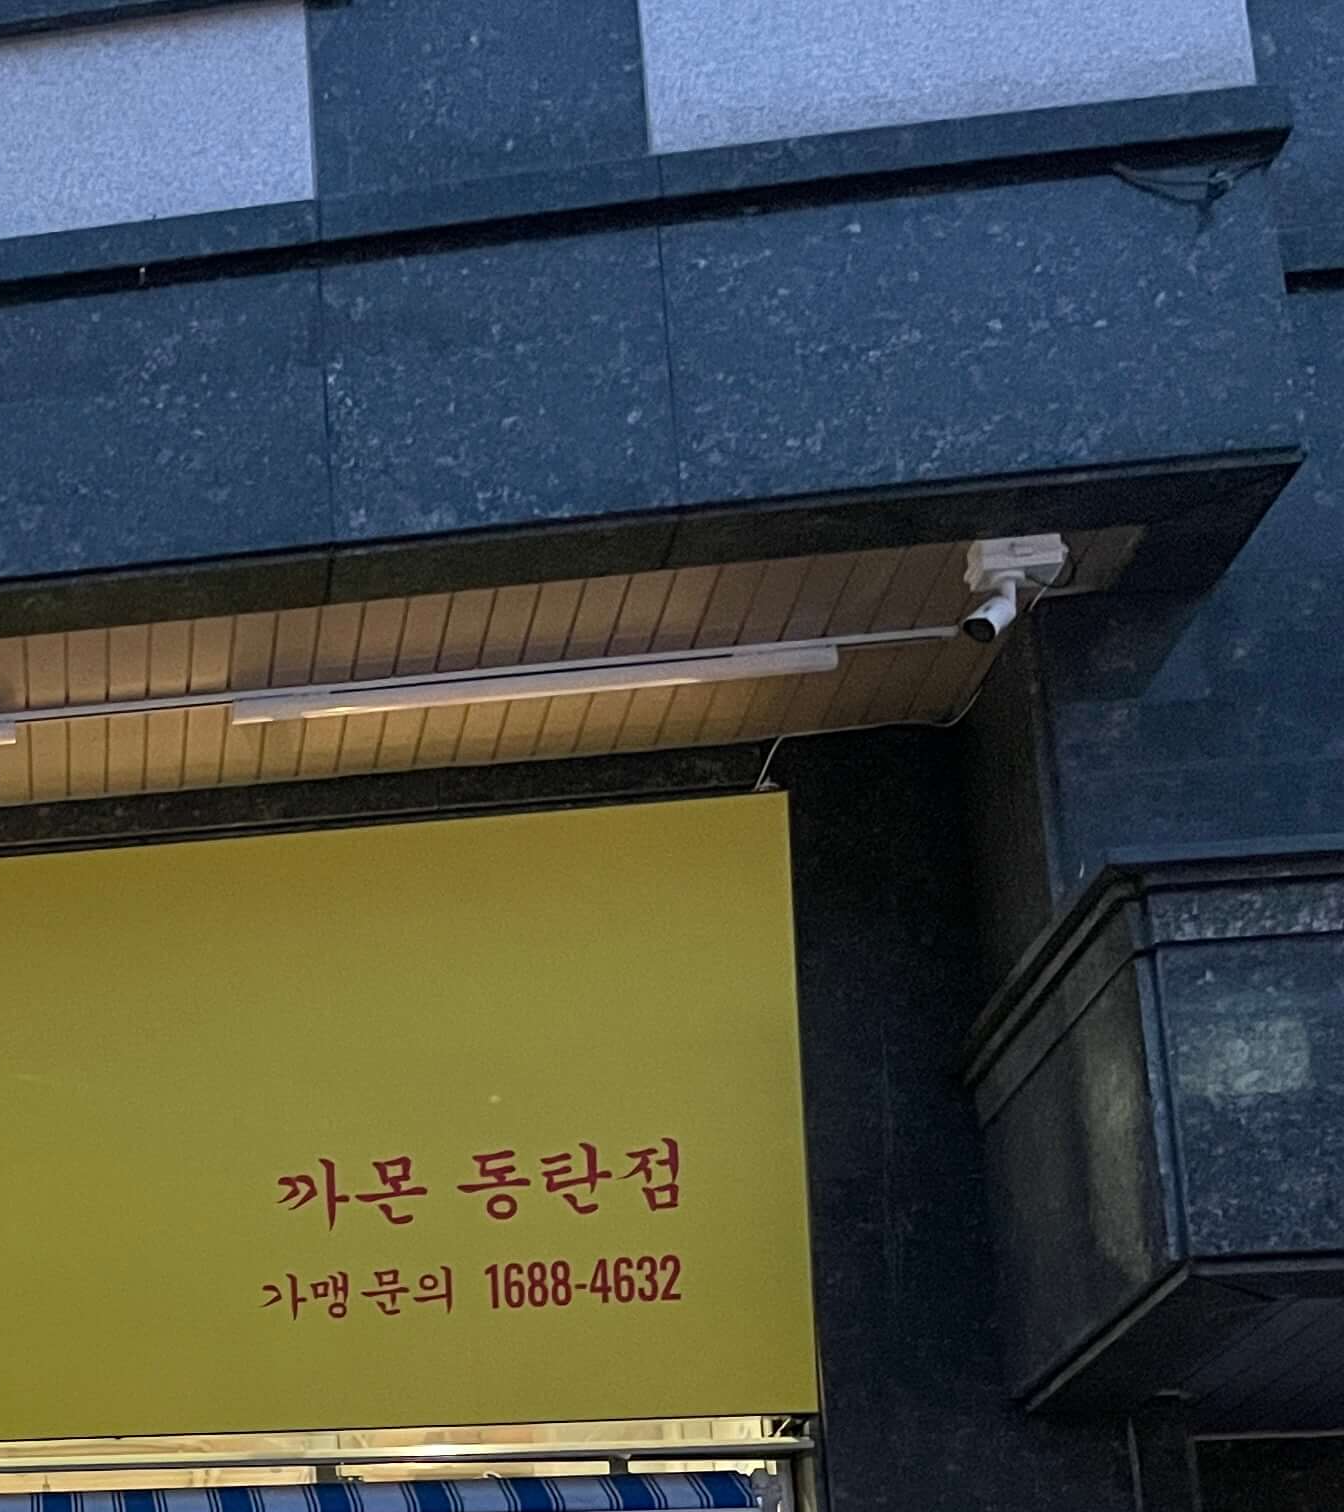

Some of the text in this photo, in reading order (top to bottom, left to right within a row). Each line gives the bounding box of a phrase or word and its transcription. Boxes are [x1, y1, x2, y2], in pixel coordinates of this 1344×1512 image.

[277, 1137, 680, 1231] 까몬 동탄점
[484, 1254, 682, 1310] 1688-4632
